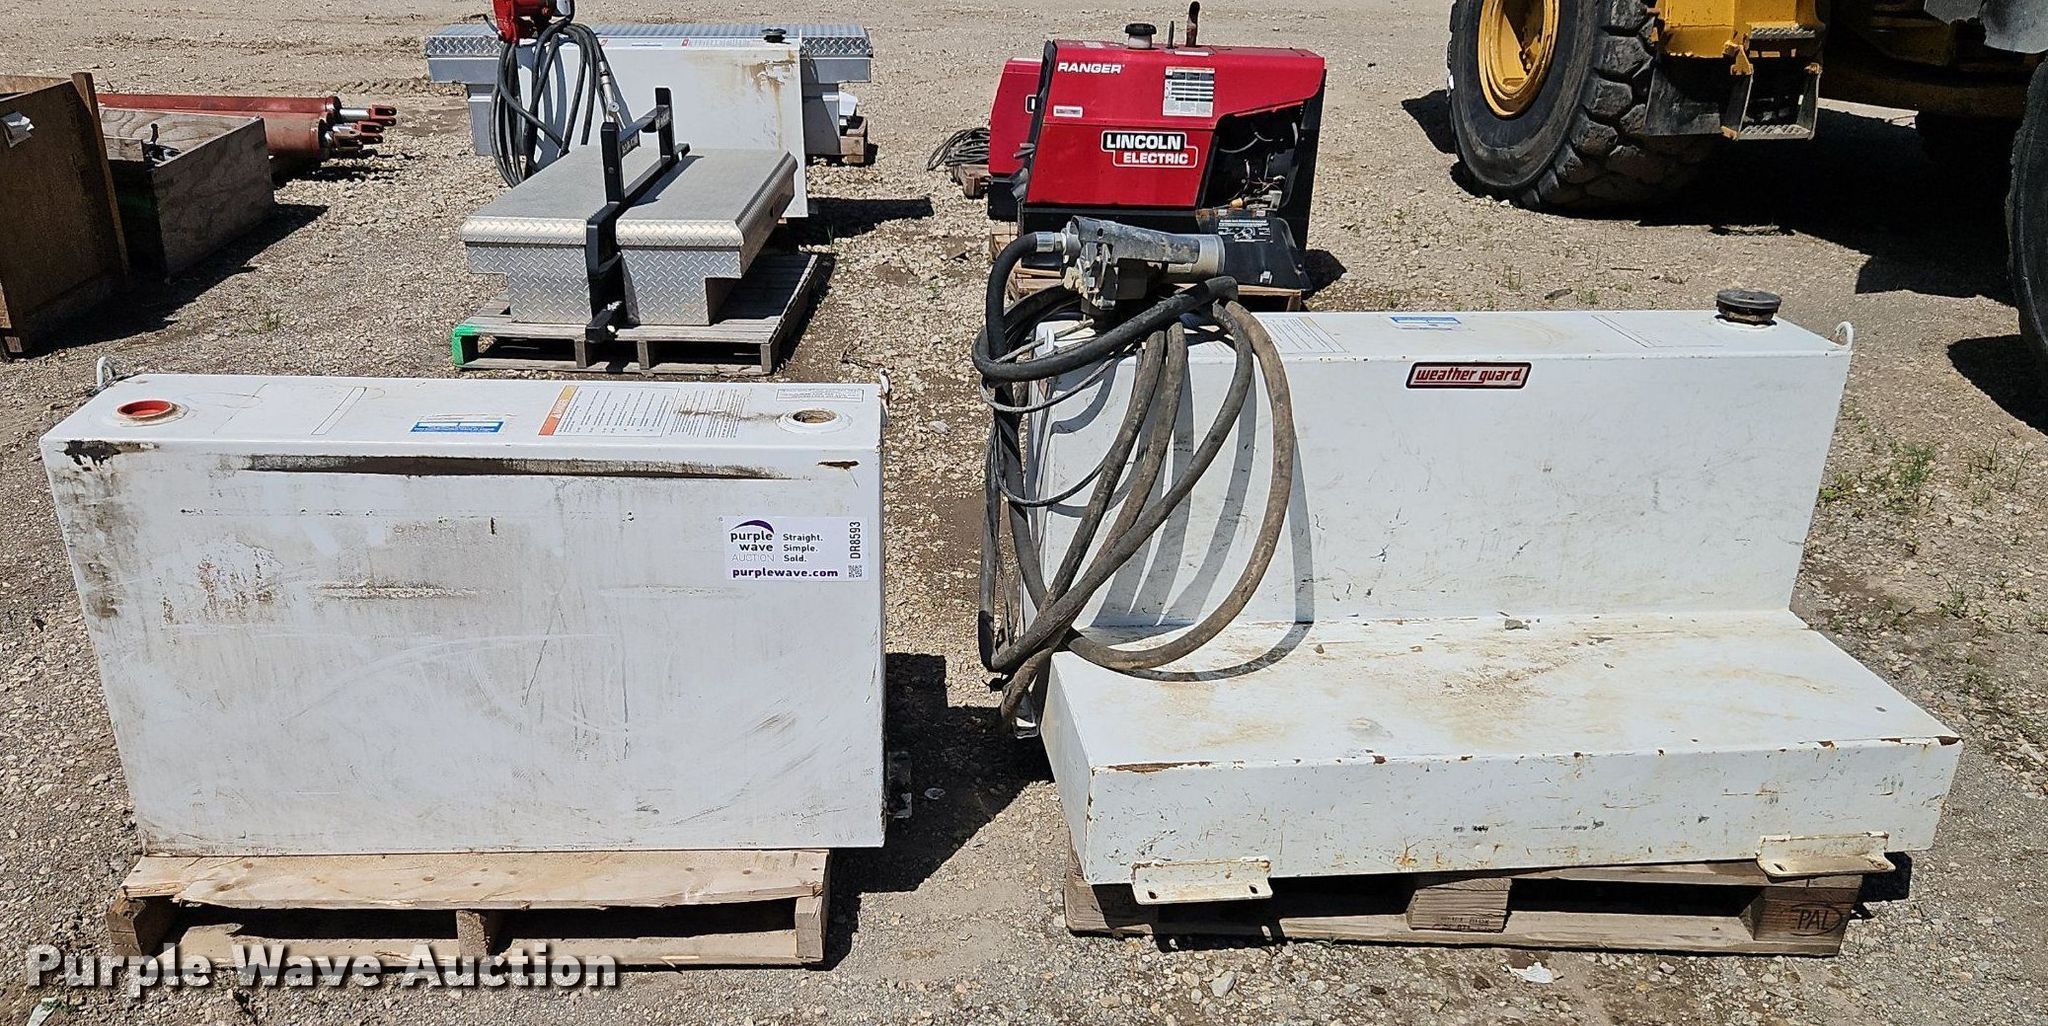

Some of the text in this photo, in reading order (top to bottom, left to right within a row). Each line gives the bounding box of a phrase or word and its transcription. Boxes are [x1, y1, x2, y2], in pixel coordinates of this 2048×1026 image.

[1057, 61, 1123, 74] RANGER
[1106, 133, 1182, 151] LINCOLN
[1122, 152, 1190, 165] ELECTRIC
[1415, 367, 1523, 384] weather guard
[730, 530, 774, 543] purple
[783, 533, 824, 543] Straight.
[849, 521, 861, 560] DR8593
[739, 544, 774, 552] wave
[783, 544, 819, 553] Simple.
[730, 553, 776, 562] AUCTION
[783, 554, 808, 562] Sold.
[732, 567, 839, 579] purplewave.com
